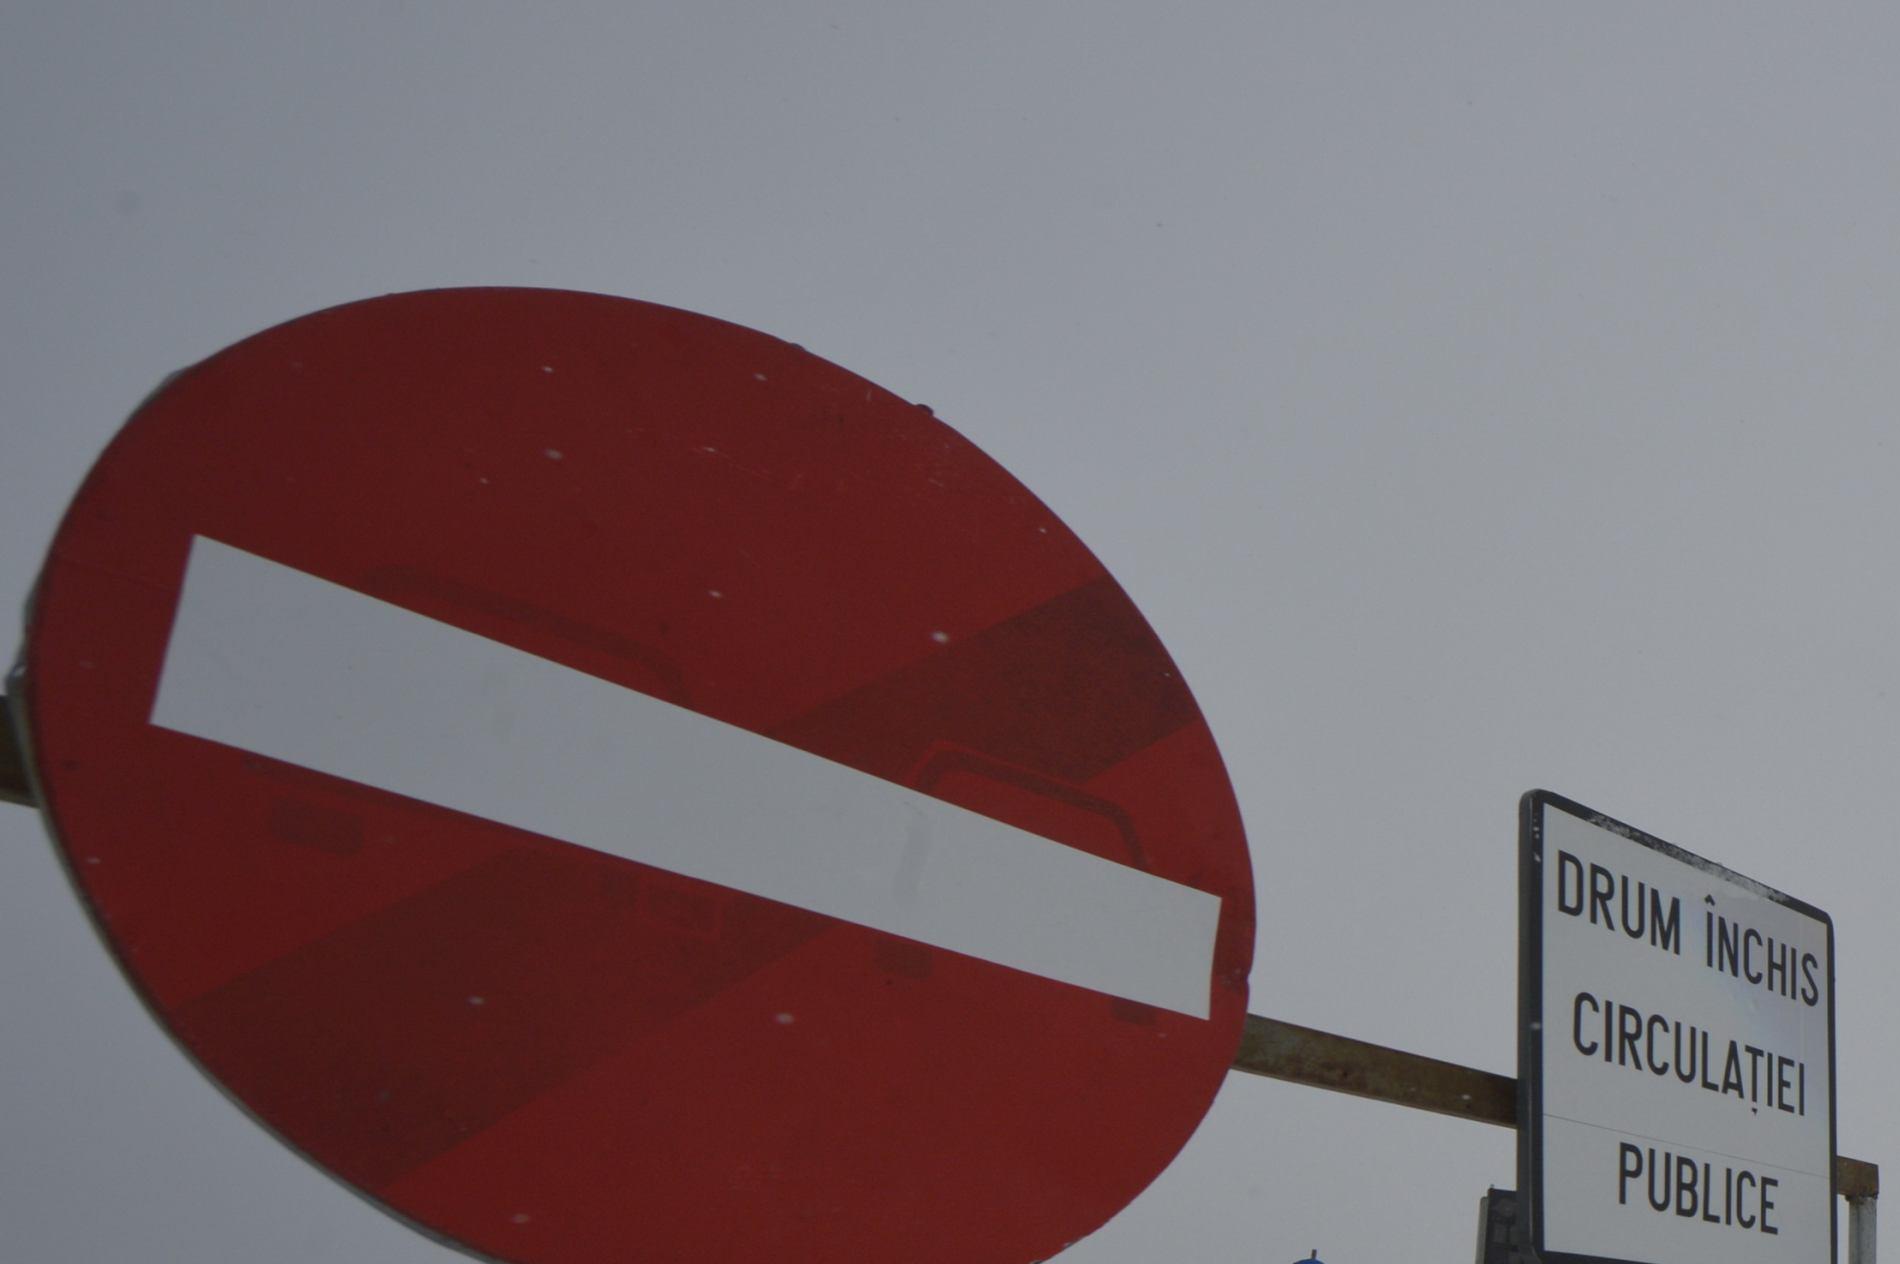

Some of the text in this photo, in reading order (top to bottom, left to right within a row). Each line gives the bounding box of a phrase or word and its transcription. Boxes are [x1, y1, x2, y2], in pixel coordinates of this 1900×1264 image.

[1557, 849, 1820, 1008] DRUM ÎNCHIS
[1618, 1141, 1779, 1236] PUBLICE
